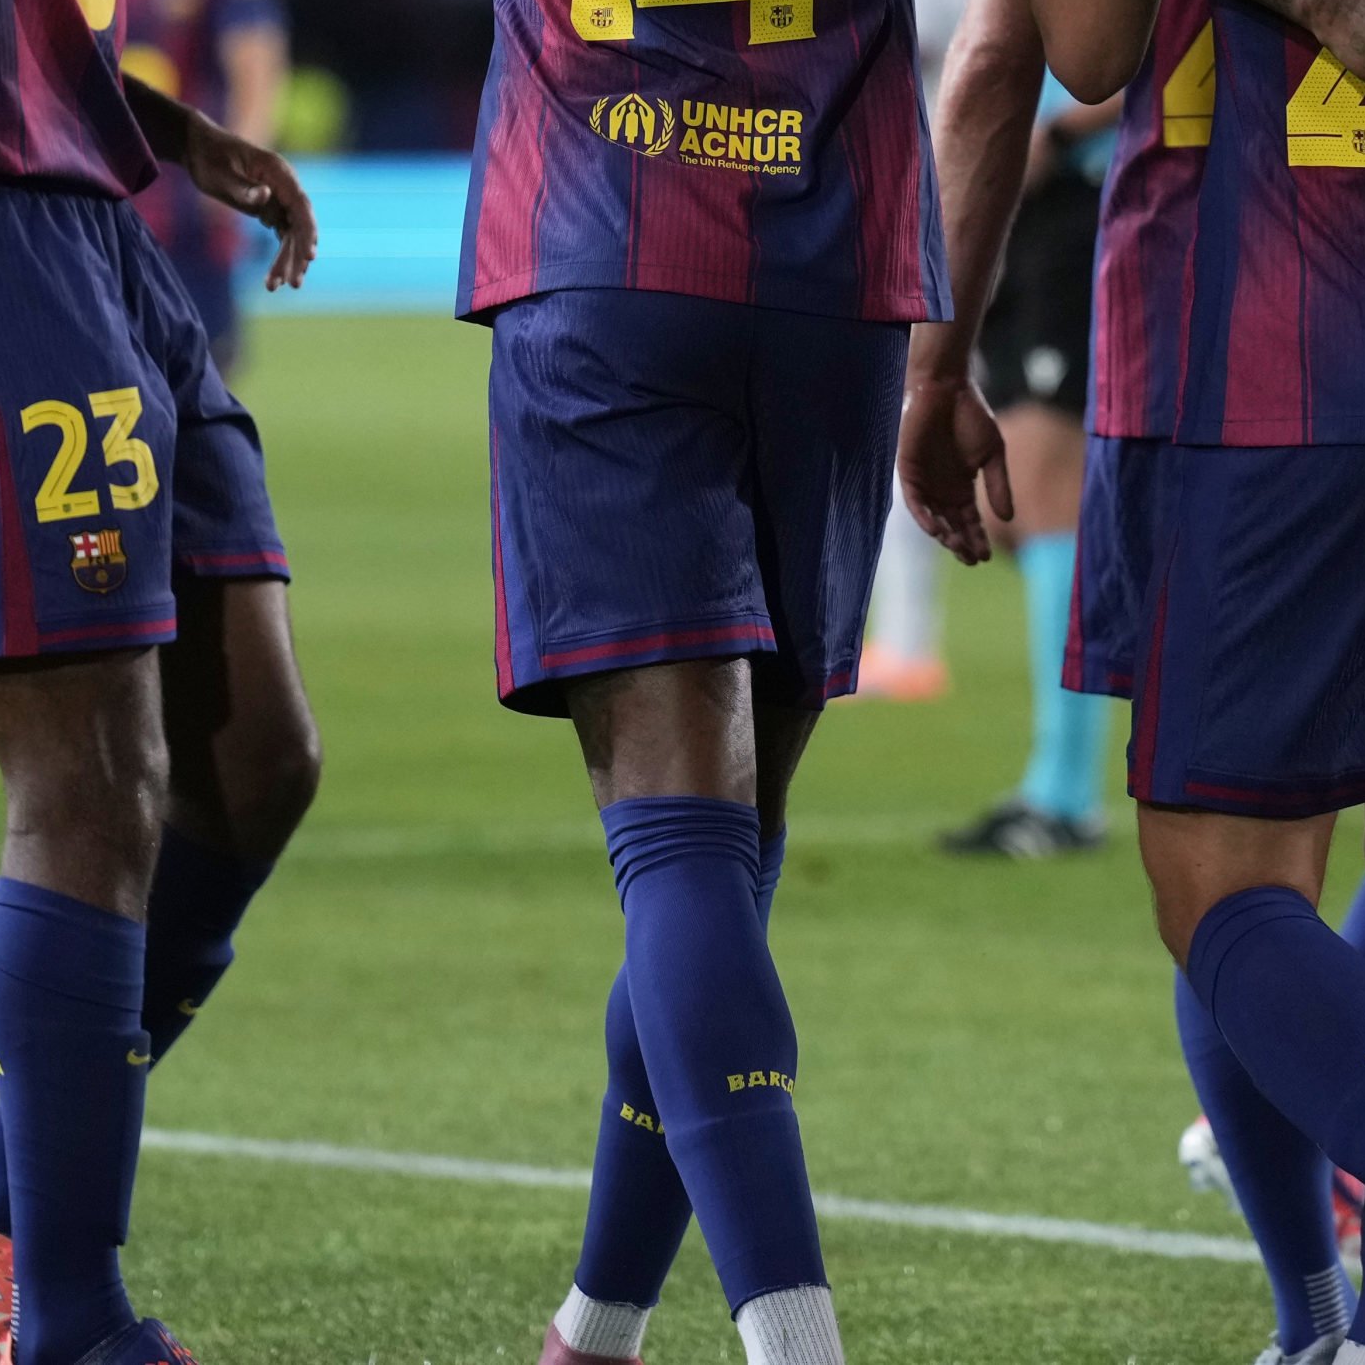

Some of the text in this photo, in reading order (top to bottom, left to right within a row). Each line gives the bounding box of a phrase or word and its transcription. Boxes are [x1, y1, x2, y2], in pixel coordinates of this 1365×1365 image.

[682, 99, 802, 135] UNHCR
[678, 128, 801, 162] ACNUR
[680, 153, 802, 176] The UN Refugee Agency
[19, 386, 160, 524] 23
